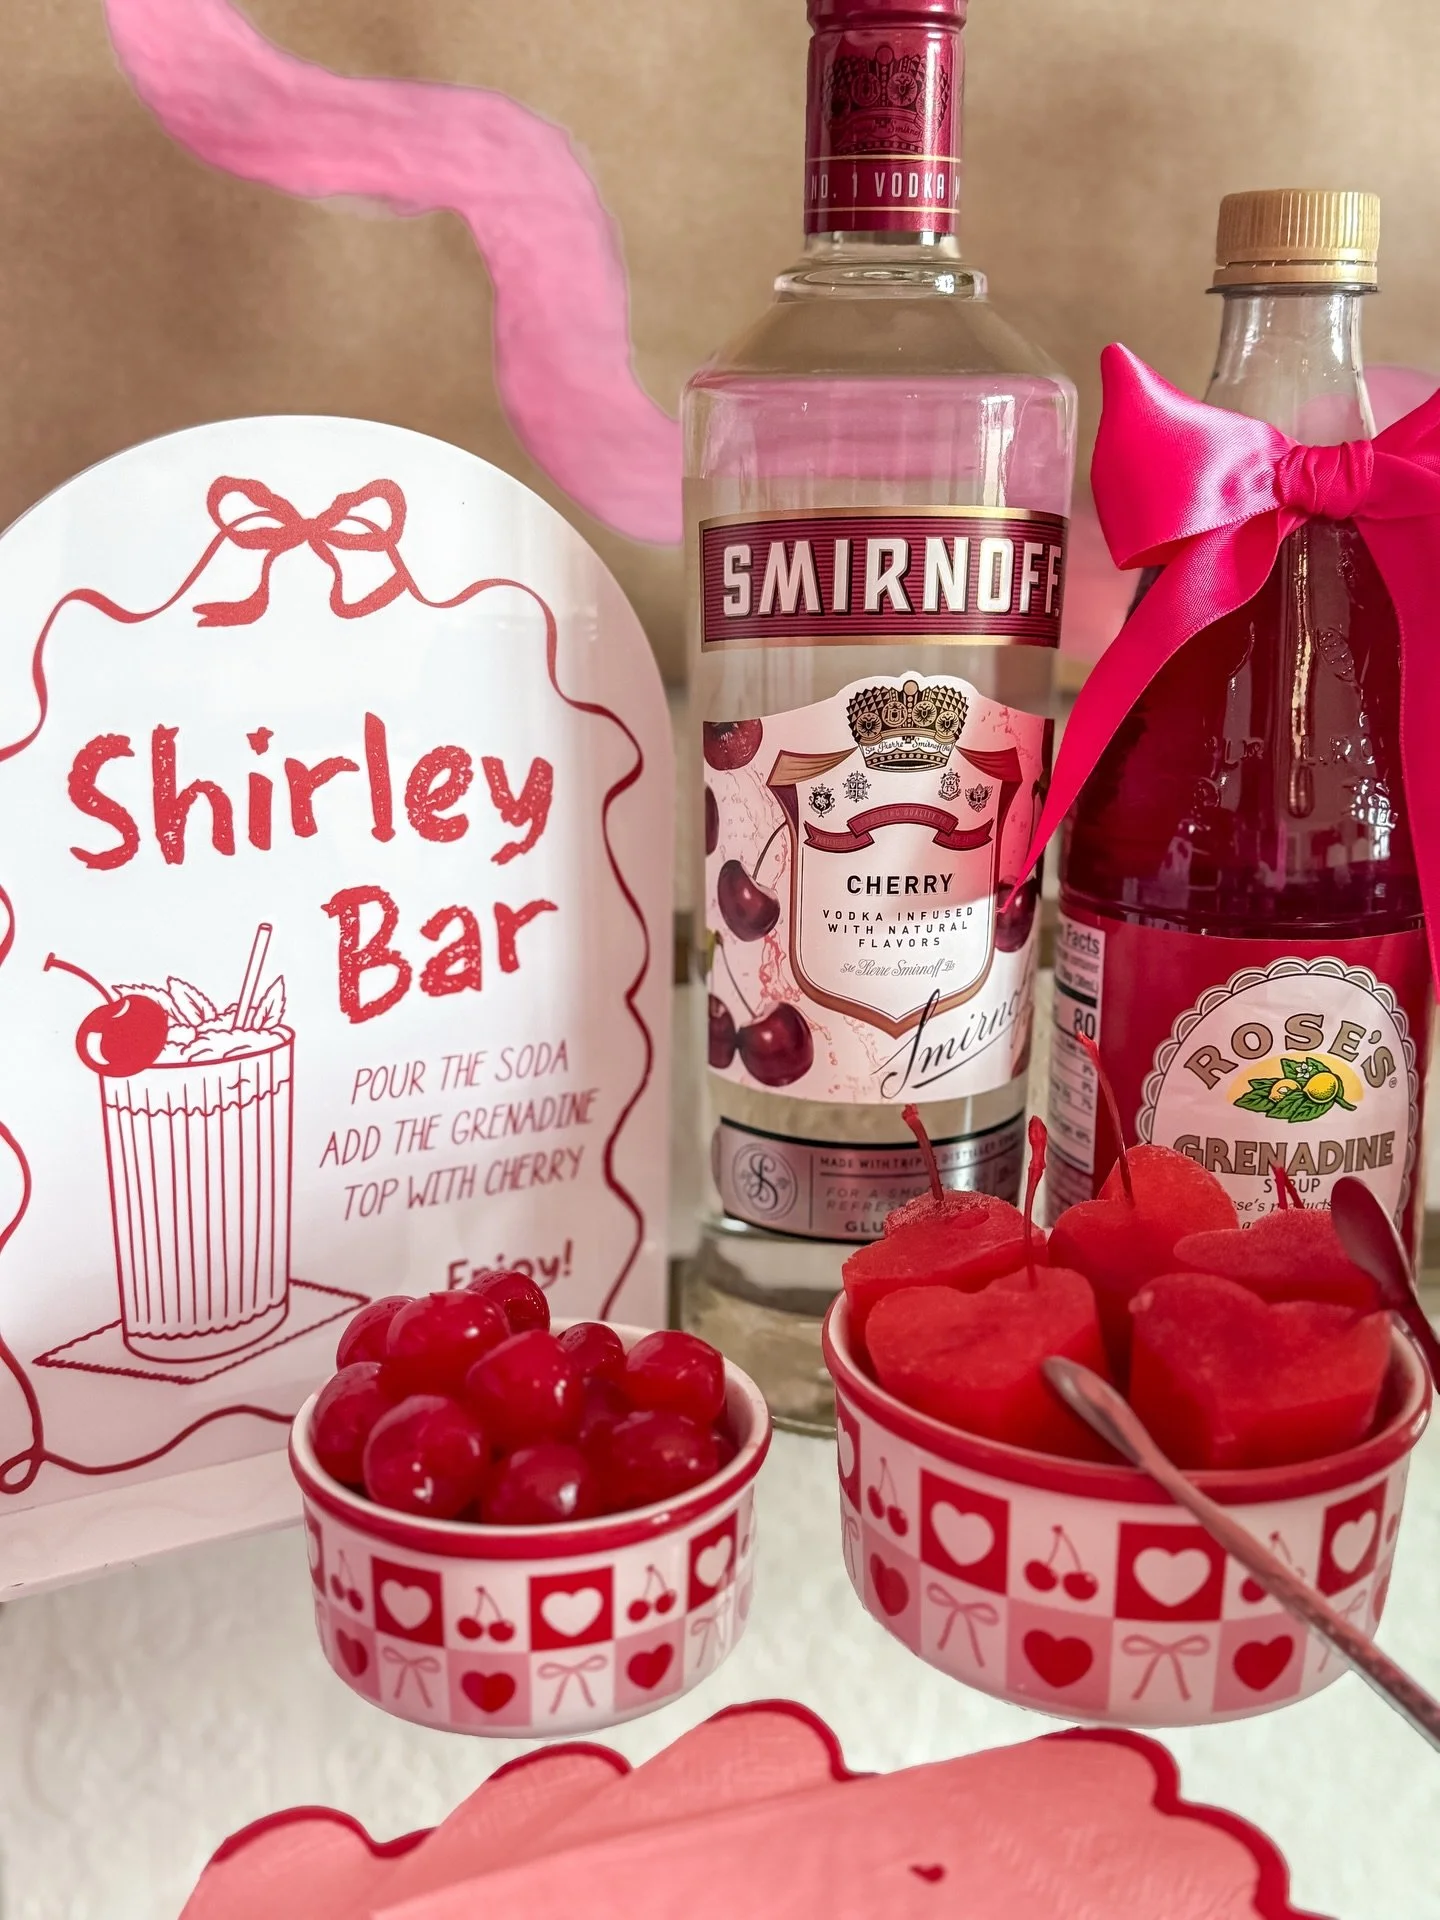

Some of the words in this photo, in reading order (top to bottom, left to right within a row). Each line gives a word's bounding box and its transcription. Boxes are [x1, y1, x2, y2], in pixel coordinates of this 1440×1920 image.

[811, 173, 838, 200] NO.
[874, 171, 946, 200] VODKA
[722, 536, 1061, 618] SMIRNOFF
[67, 712, 554, 871] Shirley
[846, 873, 954, 896] CHERRY
[822, 909, 884, 922] VODKA
[897, 906, 974, 922] INFUSED
[827, 923, 874, 935] WITH
[888, 921, 968, 935] NATURAL
[321, 885, 559, 1024] Bar
[858, 937, 941, 949] FLAVORS
[1066, 924, 1100, 956] Facts
[891, 957, 946, 978] Smirnoff
[1073, 1007, 1096, 1041] 80
[870, 987, 1022, 1100] Smirno
[1183, 1012, 1397, 1090] ROSE'S
[351, 1060, 426, 1105] POUR
[440, 1050, 489, 1092] THE
[494, 1038, 569, 1083] SODA
[318, 1124, 382, 1169] ADD
[394, 1113, 443, 1156] THE
[451, 1087, 600, 1146] GRENADINE
[820, 1156, 852, 1169] MADE
[860, 1158, 891, 1170] WITH
[893, 1156, 931, 1171] TRIP
[1172, 1130, 1396, 1178] GRENADINE
[343, 1177, 400, 1222] TOP
[406, 1163, 478, 1210] WITH
[484, 1145, 585, 1197] CHERRY
[825, 1186, 859, 1198] FOR
[868, 1188, 879, 1198] A
[1263, 1177, 1321, 1194] SUP
[1234, 1198, 1266, 1213] se's
[844, 1220, 884, 1234] GLU
[447, 1237, 573, 1291] Eoy!
